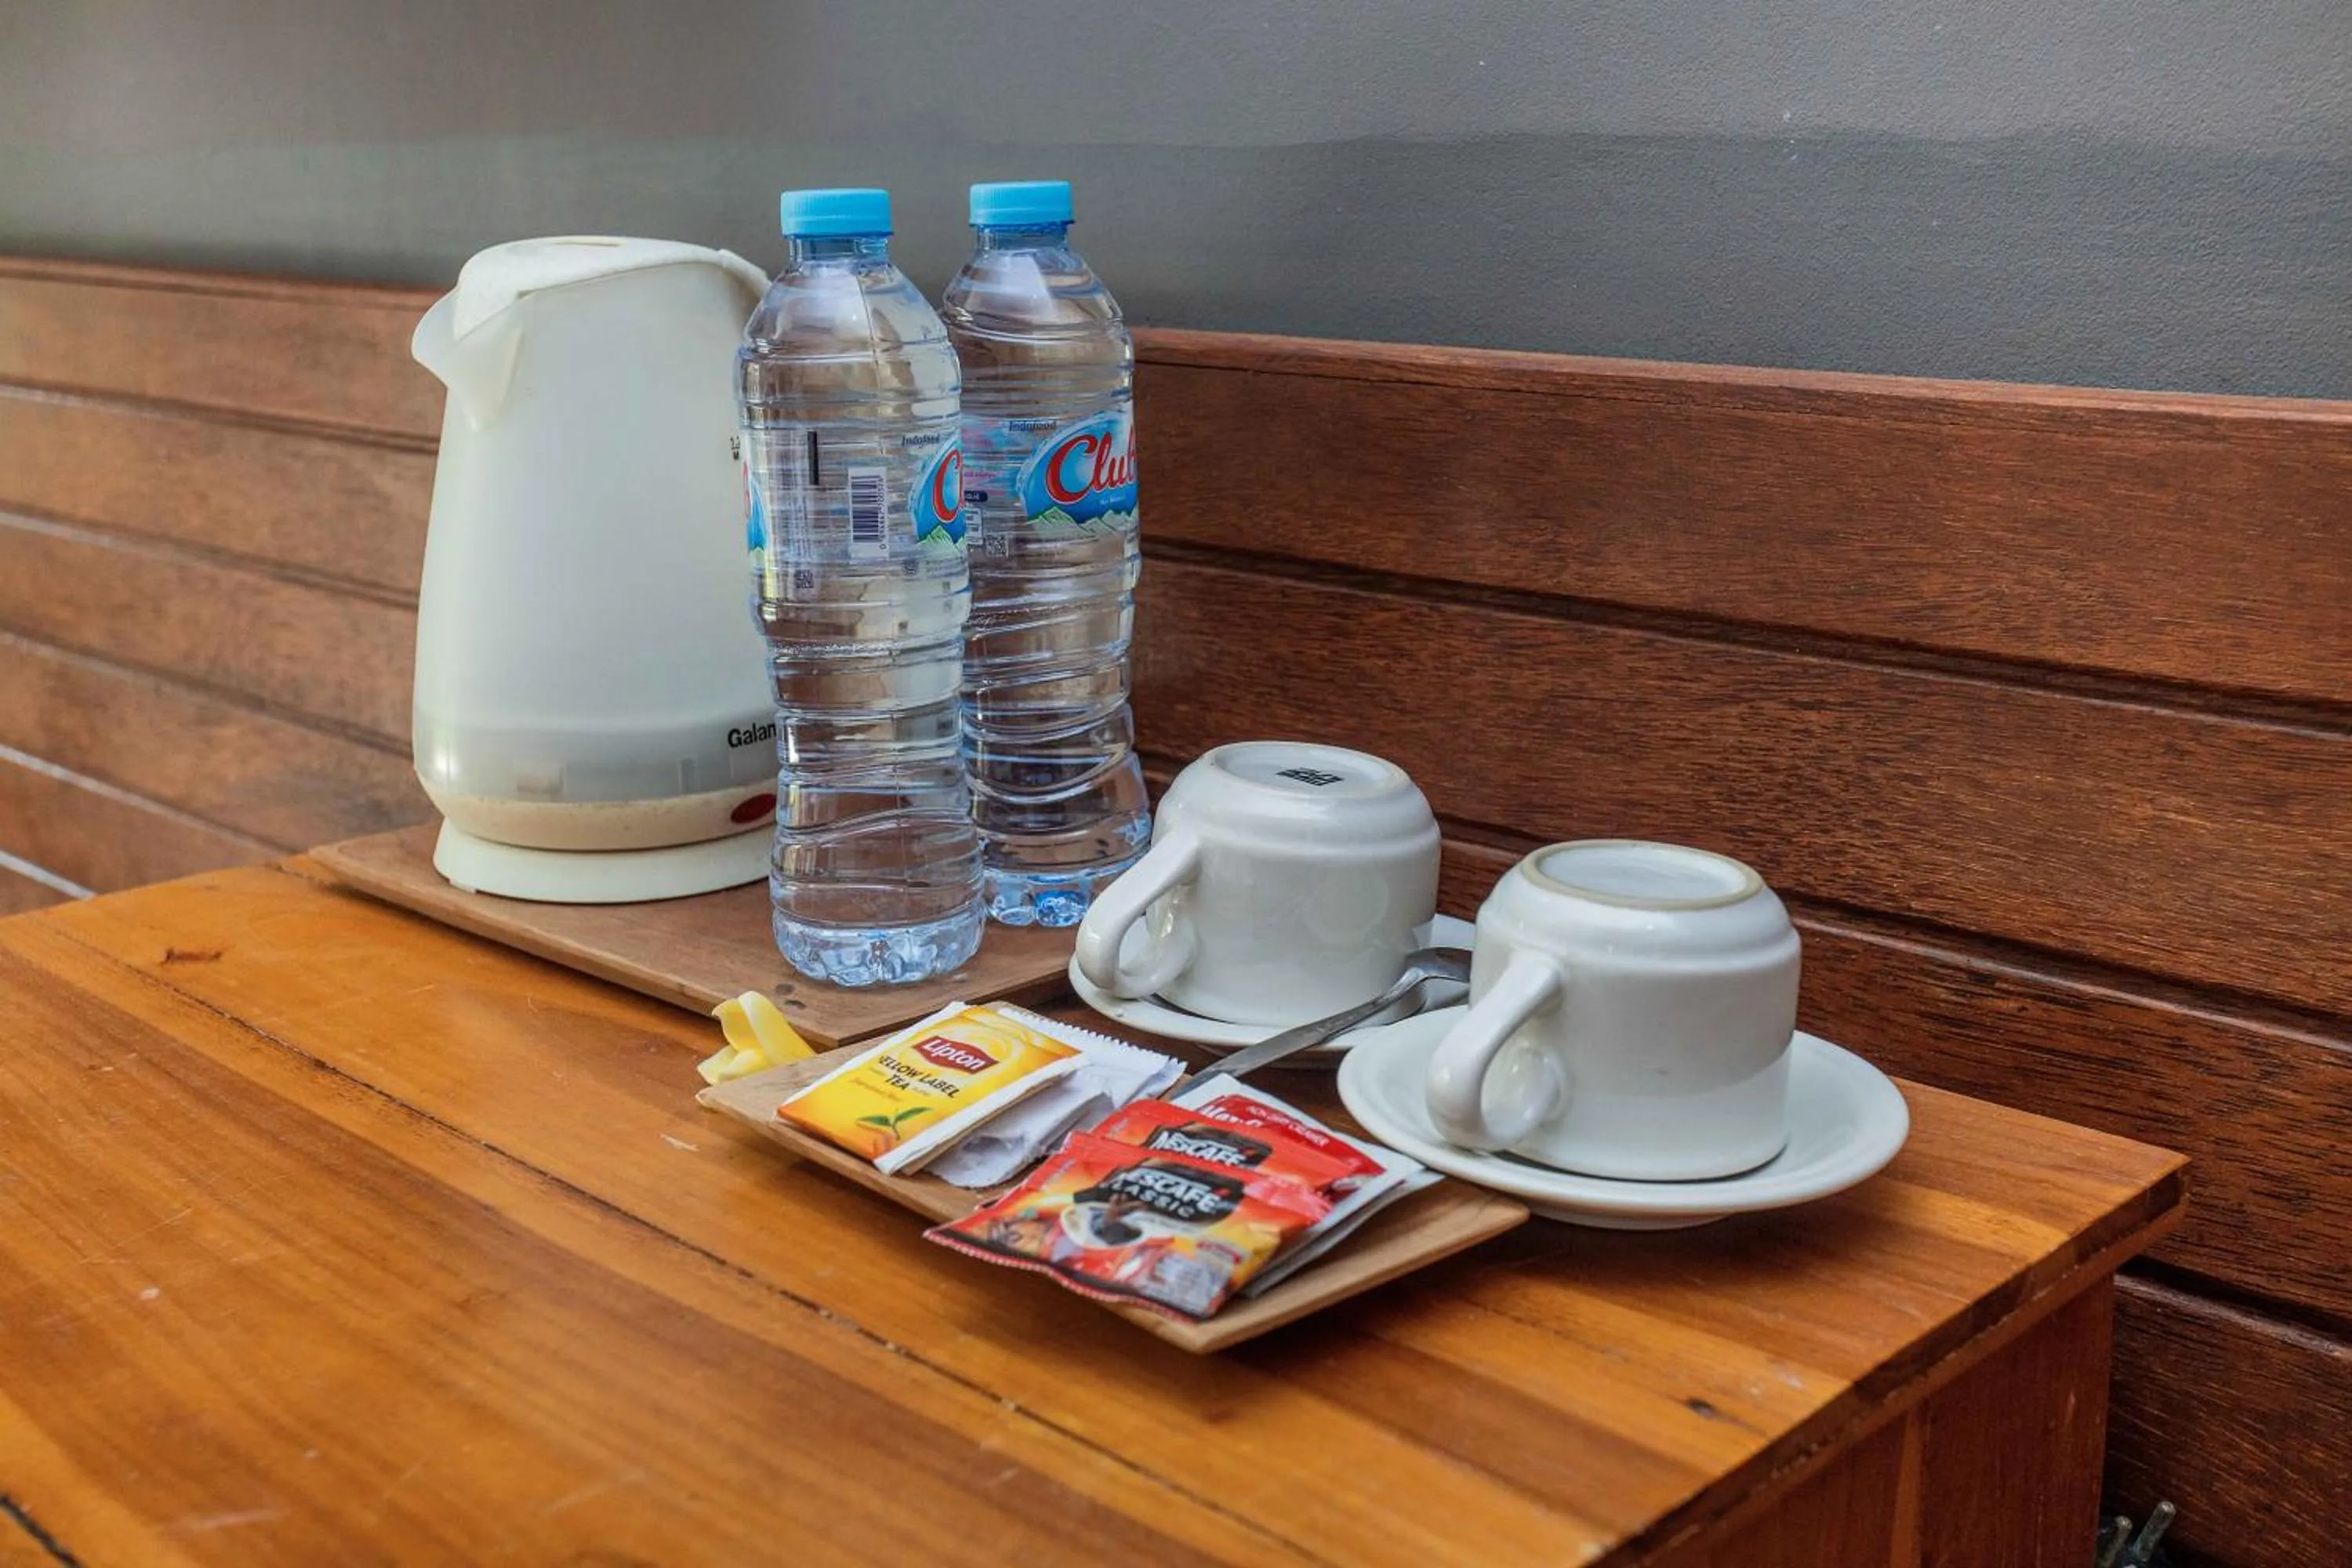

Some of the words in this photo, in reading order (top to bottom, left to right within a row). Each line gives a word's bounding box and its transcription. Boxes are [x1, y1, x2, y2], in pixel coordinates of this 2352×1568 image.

[727, 722, 777, 748] Galan
[921, 1039, 988, 1071] Lipton
[884, 1074, 910, 1091] TEA
[918, 1073, 960, 1098] LABEL
